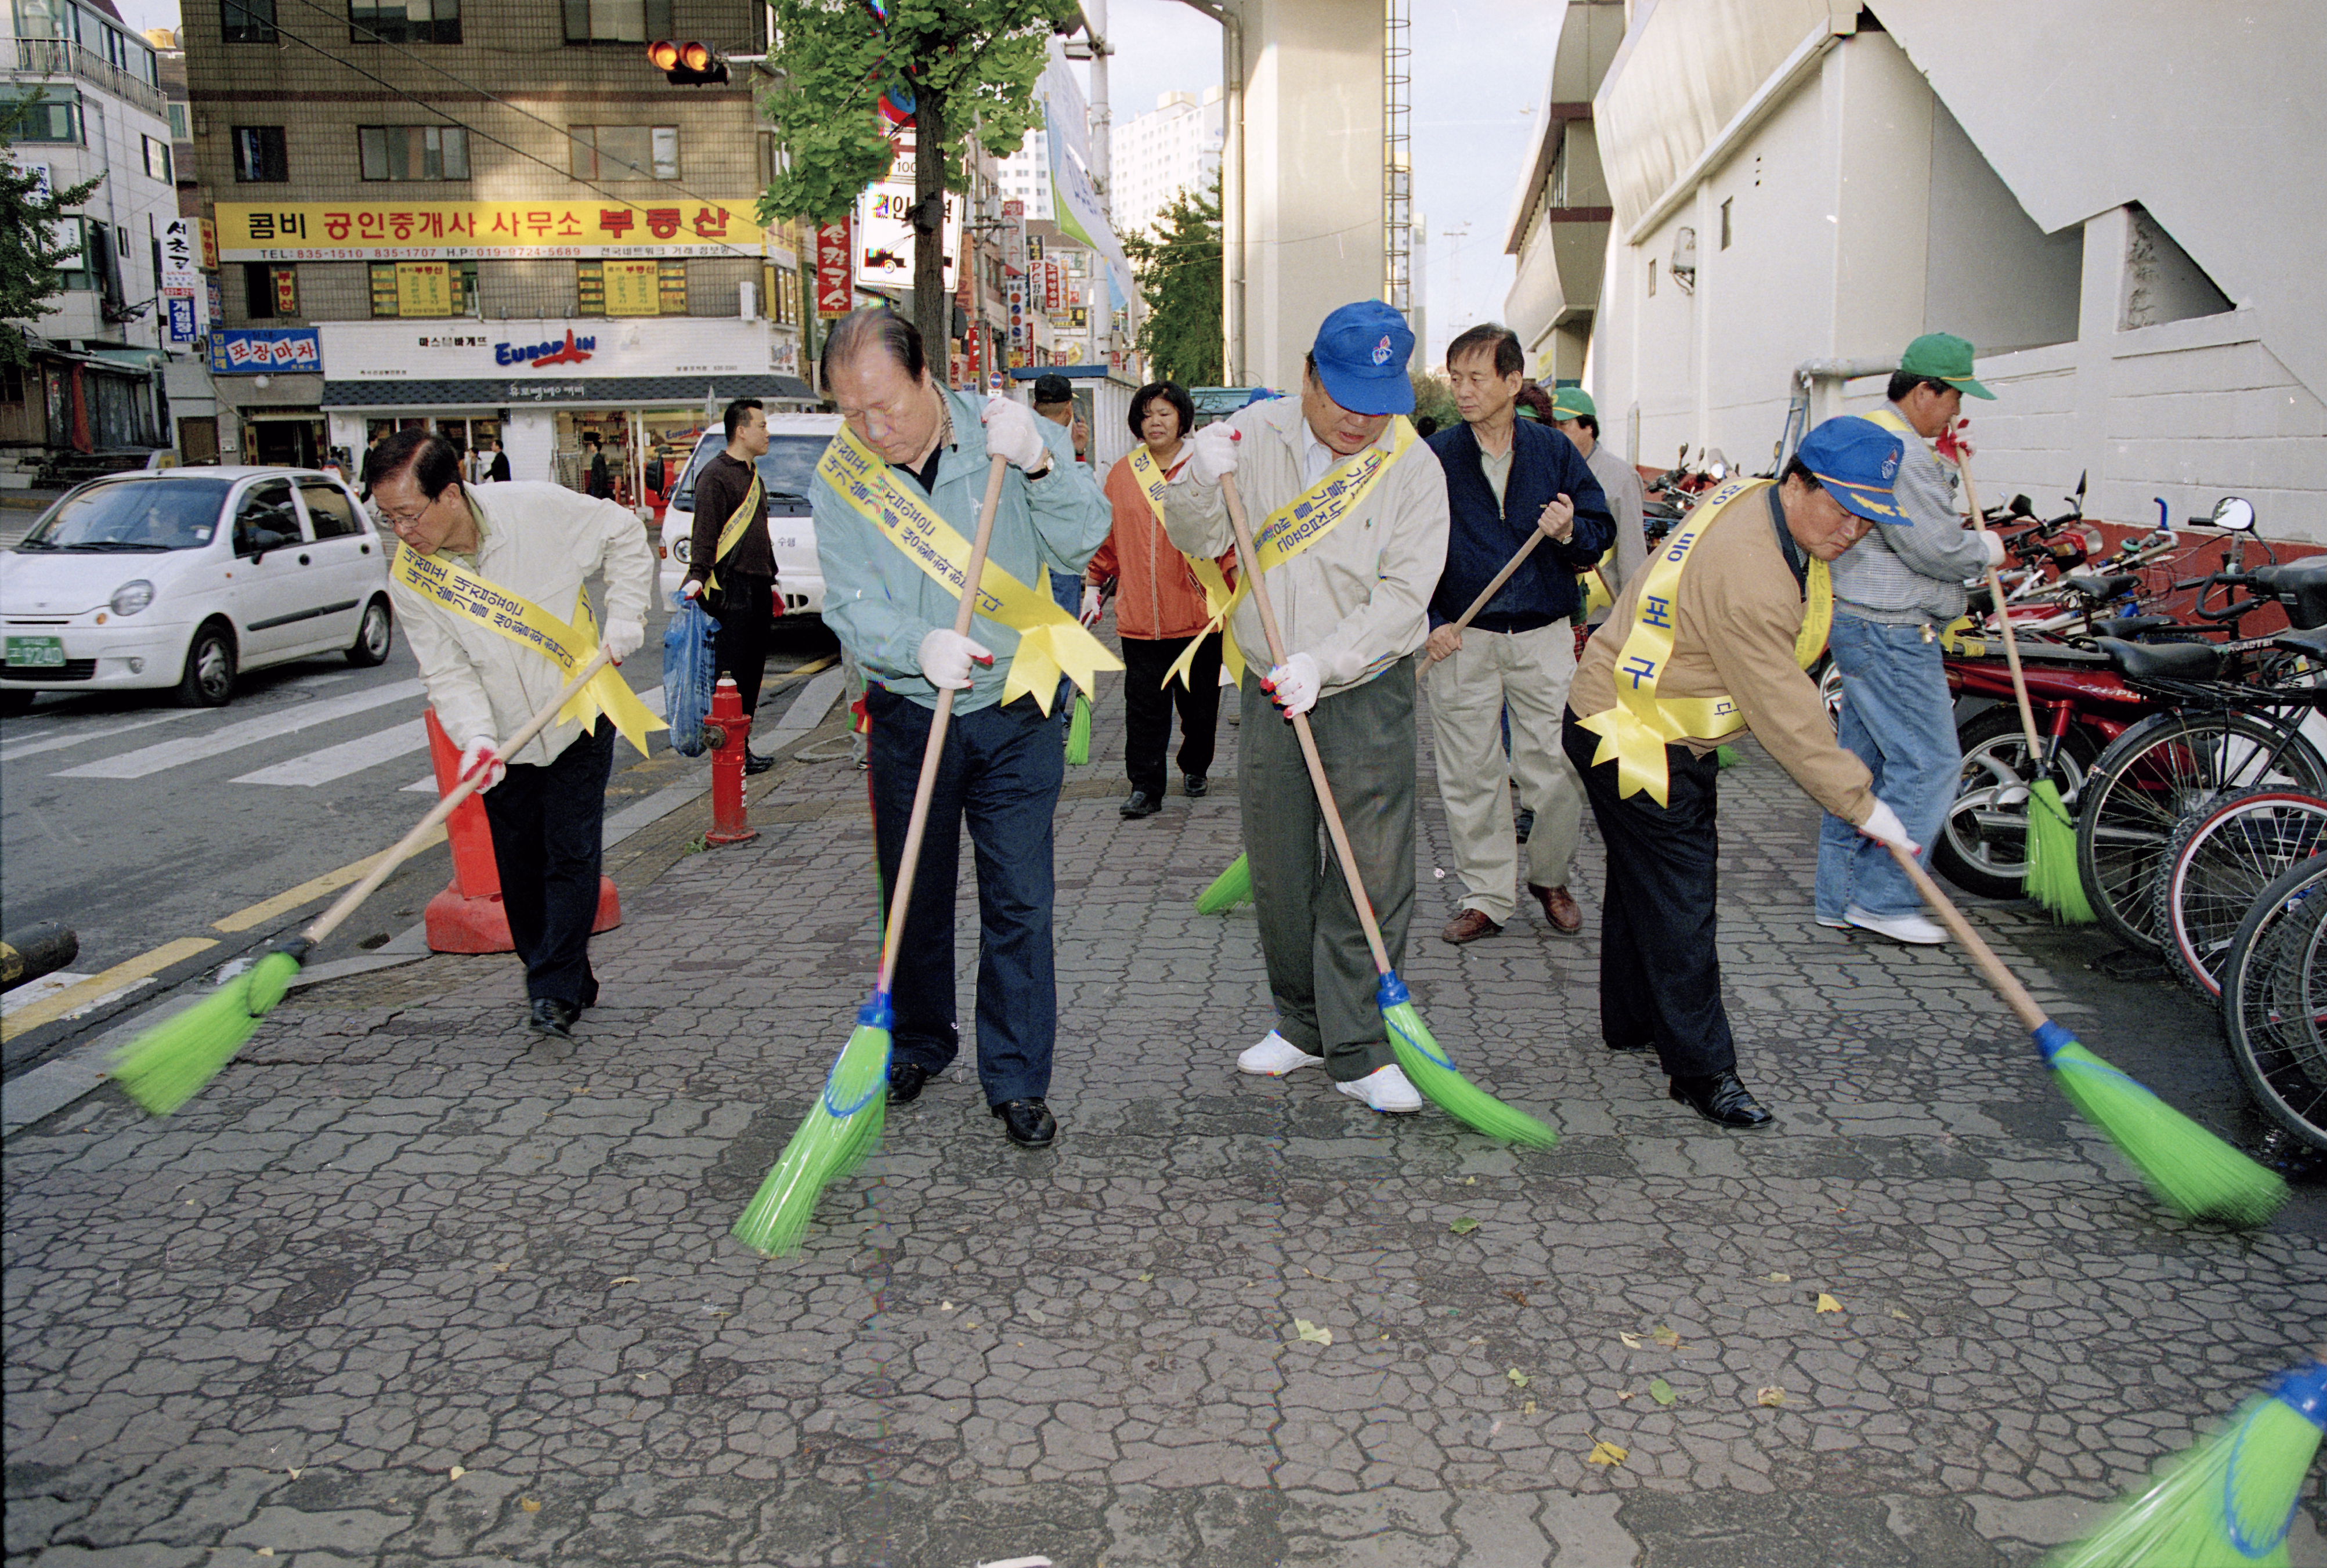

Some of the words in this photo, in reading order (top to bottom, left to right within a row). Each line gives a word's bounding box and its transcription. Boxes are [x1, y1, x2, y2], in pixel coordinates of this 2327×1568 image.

[249, 213, 306, 239] 콤비
[324, 212, 476, 240] 공인중개사
[492, 211, 582, 237] 사무소
[600, 207, 729, 239] 부동산
[374, 248, 436, 258] 835-1707
[601, 247, 665, 256] 전국네트워크
[673, 246, 693, 255] 거래
[821, 224, 848, 310] 손칼국수
[231, 341, 315, 362] 포장마차
[778, 537, 796, 547] 수행
[403, 547, 448, 581] 내점포
[452, 575, 523, 616] 내집앞은
[406, 568, 489, 617] 내가쓸기를
